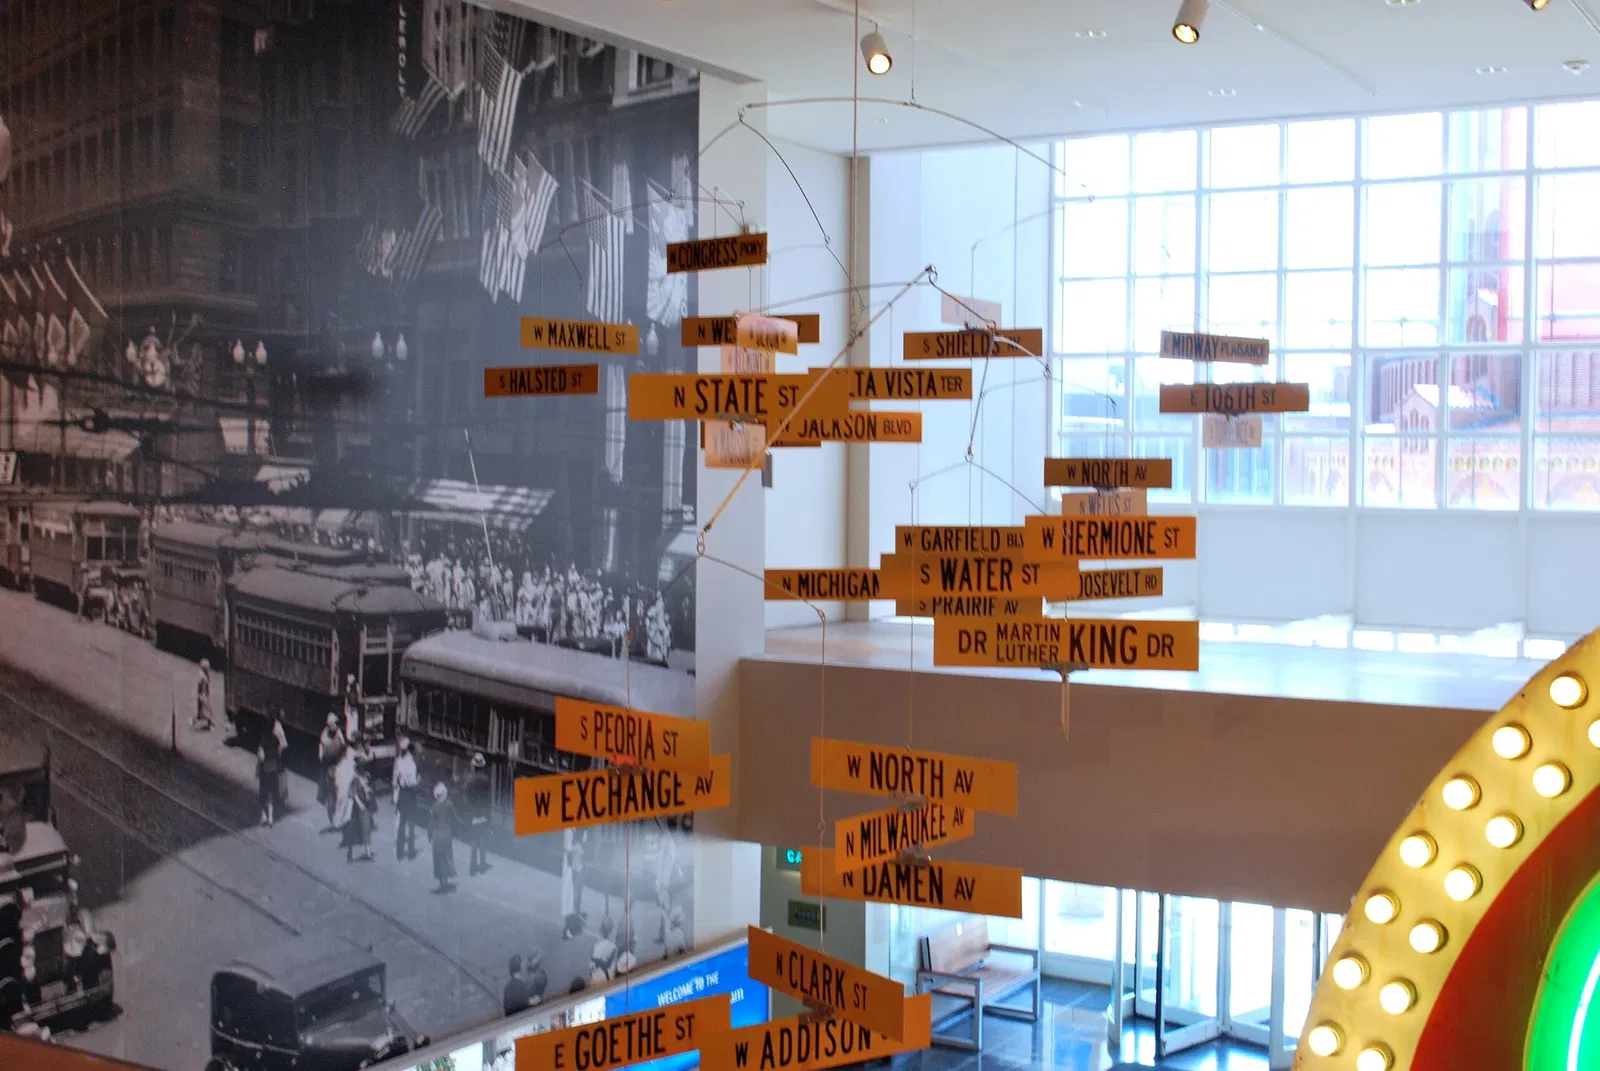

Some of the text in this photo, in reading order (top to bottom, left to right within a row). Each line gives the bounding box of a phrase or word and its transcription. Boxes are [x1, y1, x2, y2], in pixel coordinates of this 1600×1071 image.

[680, 238, 738, 269] CONGRESS
[534, 321, 626, 351] W MAXWELL ST
[698, 324, 706, 340] N
[923, 338, 931, 354] S
[936, 332, 1001, 358] SHIELDS
[1172, 332, 1219, 360] MIDWAY
[1221, 342, 1266, 359] PLAISANCE
[500, 367, 583, 393] S HALSTED ST
[884, 369, 937, 397] VISTA
[940, 375, 963, 393] TER
[674, 379, 799, 414] N STATE ST
[1190, 386, 1277, 411] E 106TH ST
[798, 414, 877, 440] JACKSON
[883, 418, 912, 437] BLVD
[1067, 461, 1147, 485] W NORTH AV
[904, 531, 914, 548] W
[921, 527, 1000, 552] GARFIELD
[1042, 520, 1181, 555] W HERMIONE ST
[783, 576, 792, 592] N
[920, 557, 1040, 592] S WATER ST
[1145, 575, 1158, 590] RD
[1004, 602, 1019, 616] AV
[958, 623, 1175, 666] DR MARTIN LUTHER KING DR
[580, 710, 678, 764] S PEORIA ST
[847, 751, 975, 799] W NORTH AV
[535, 769, 714, 823] W EXCHANGE AV
[846, 803, 965, 861] N MILWAUKEE AV
[843, 863, 976, 905] N DAMEN AV
[657, 970, 720, 1007] WELCOME TO THE
[776, 951, 868, 1011] N CLARK ST
[555, 1013, 696, 1071] E GOETHE ST
[735, 1018, 872, 1071] W ADDISON
